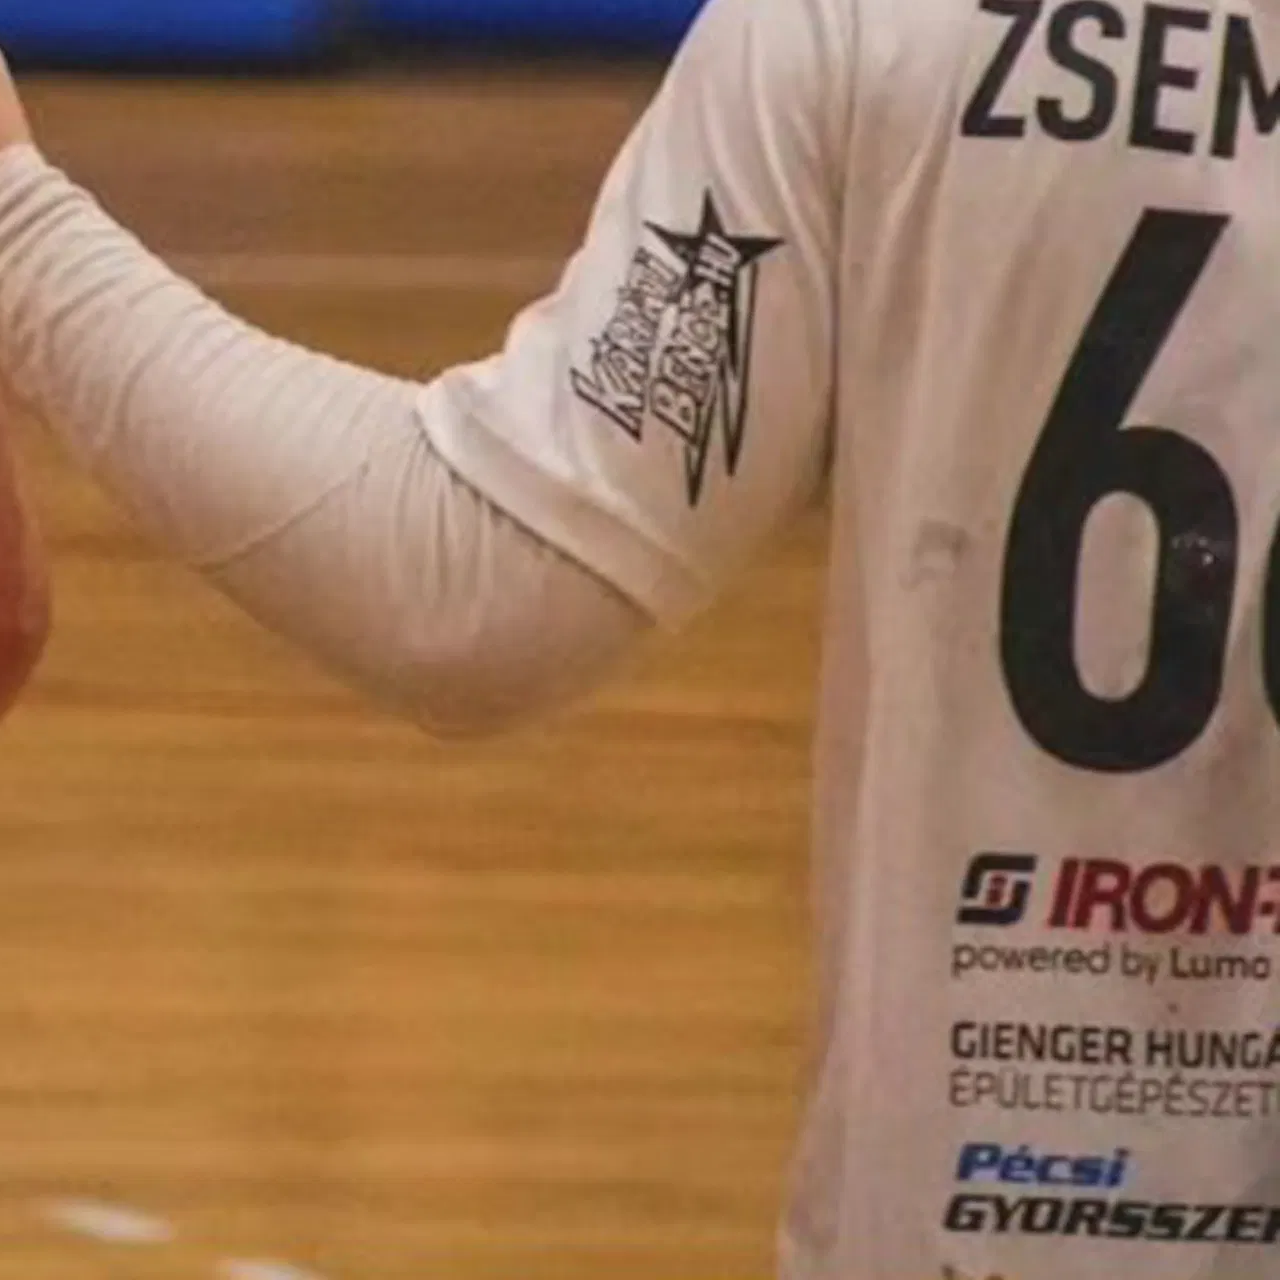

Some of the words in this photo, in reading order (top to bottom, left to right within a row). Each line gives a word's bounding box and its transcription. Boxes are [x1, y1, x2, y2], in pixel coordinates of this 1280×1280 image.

[998, 208, 1280, 774] 6
[950, 940, 1110, 980] powered
[1120, 945, 1160, 985] by
[949, 1020, 1134, 1064] GIENGER
[954, 1141, 1131, 1188] Pécsi
